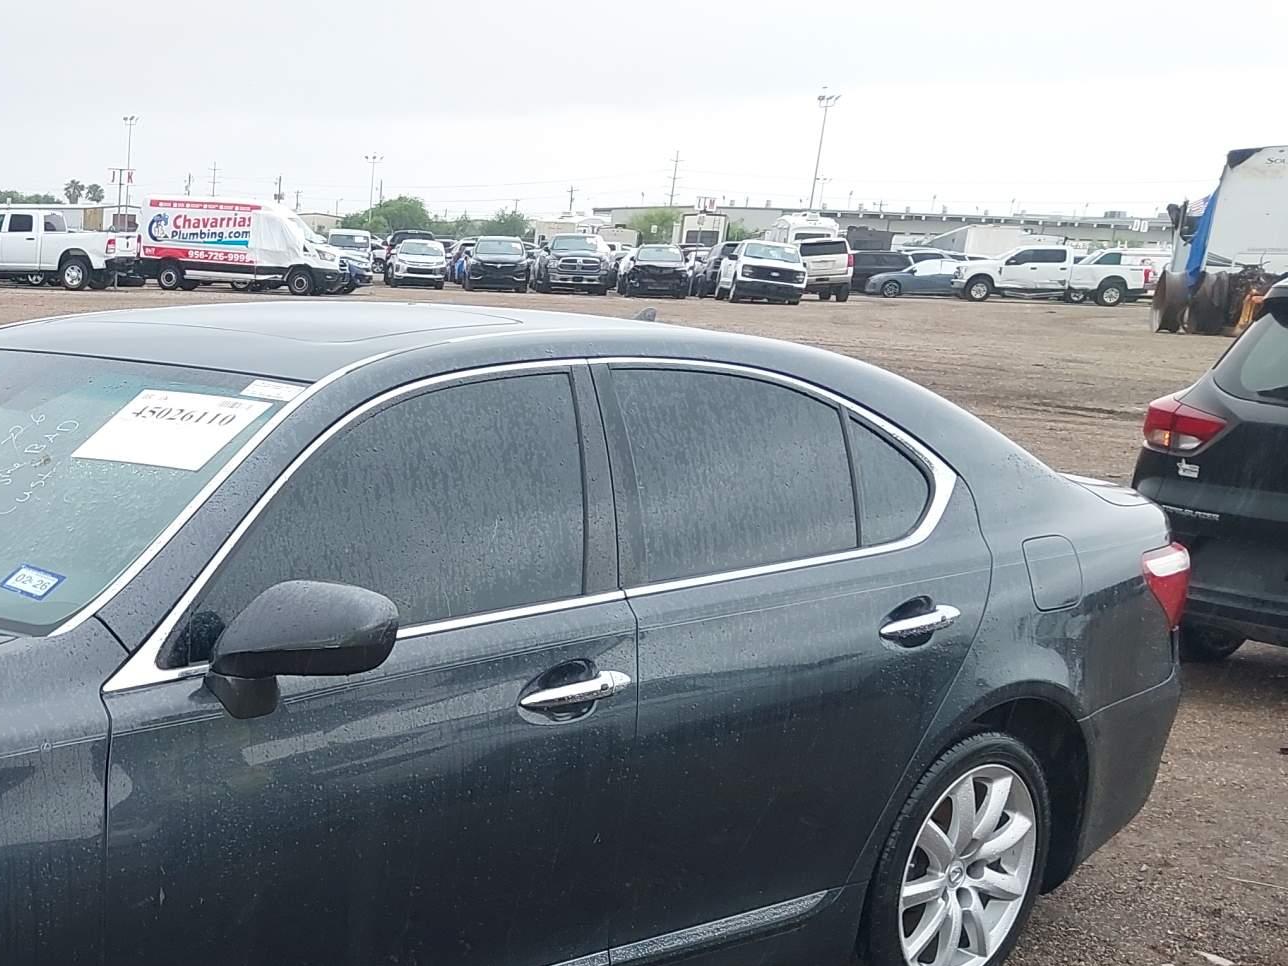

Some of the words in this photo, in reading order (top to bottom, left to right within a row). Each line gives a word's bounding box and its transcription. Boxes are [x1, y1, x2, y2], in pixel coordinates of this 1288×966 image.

[127, 171, 134, 184] K
[171, 229, 251, 242] Plumbing.com
[132, 405, 236, 426] 45026110
